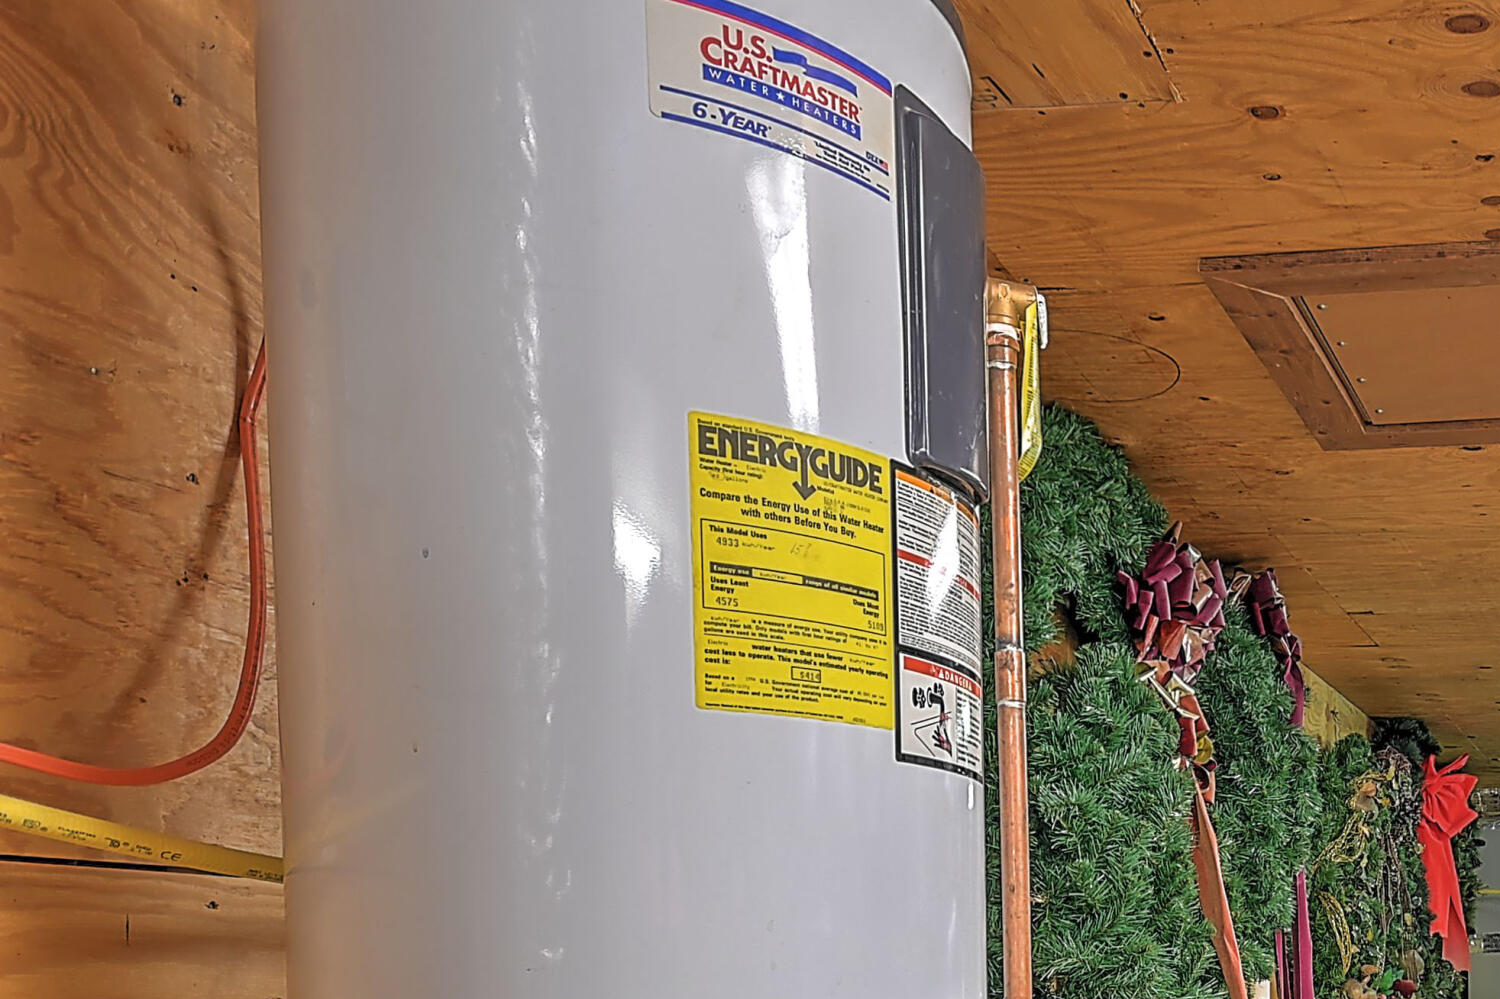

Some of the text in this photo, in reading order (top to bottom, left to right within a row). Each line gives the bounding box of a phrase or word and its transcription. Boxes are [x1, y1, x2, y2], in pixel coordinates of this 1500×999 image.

[723, 24, 773, 62] U.S.
[700, 36, 861, 123] CRAFTMASTER
[708, 68, 857, 135] WATER HEATERS
[697, 423, 883, 500] ENERGYGUIDE
[699, 487, 884, 534] Compare the Energy Use of this Water Heater
[740, 507, 761, 519] with
[764, 513, 791, 524] others
[794, 516, 821, 530] Before
[823, 522, 838, 534] You
[708, 524, 768, 540] This Model Uses
[715, 536, 740, 548] 4933
[710, 576, 728, 585] Uses
[710, 584, 735, 594] Energy
[715, 596, 739, 608] 4575
[160, 850, 182, 862] CE
